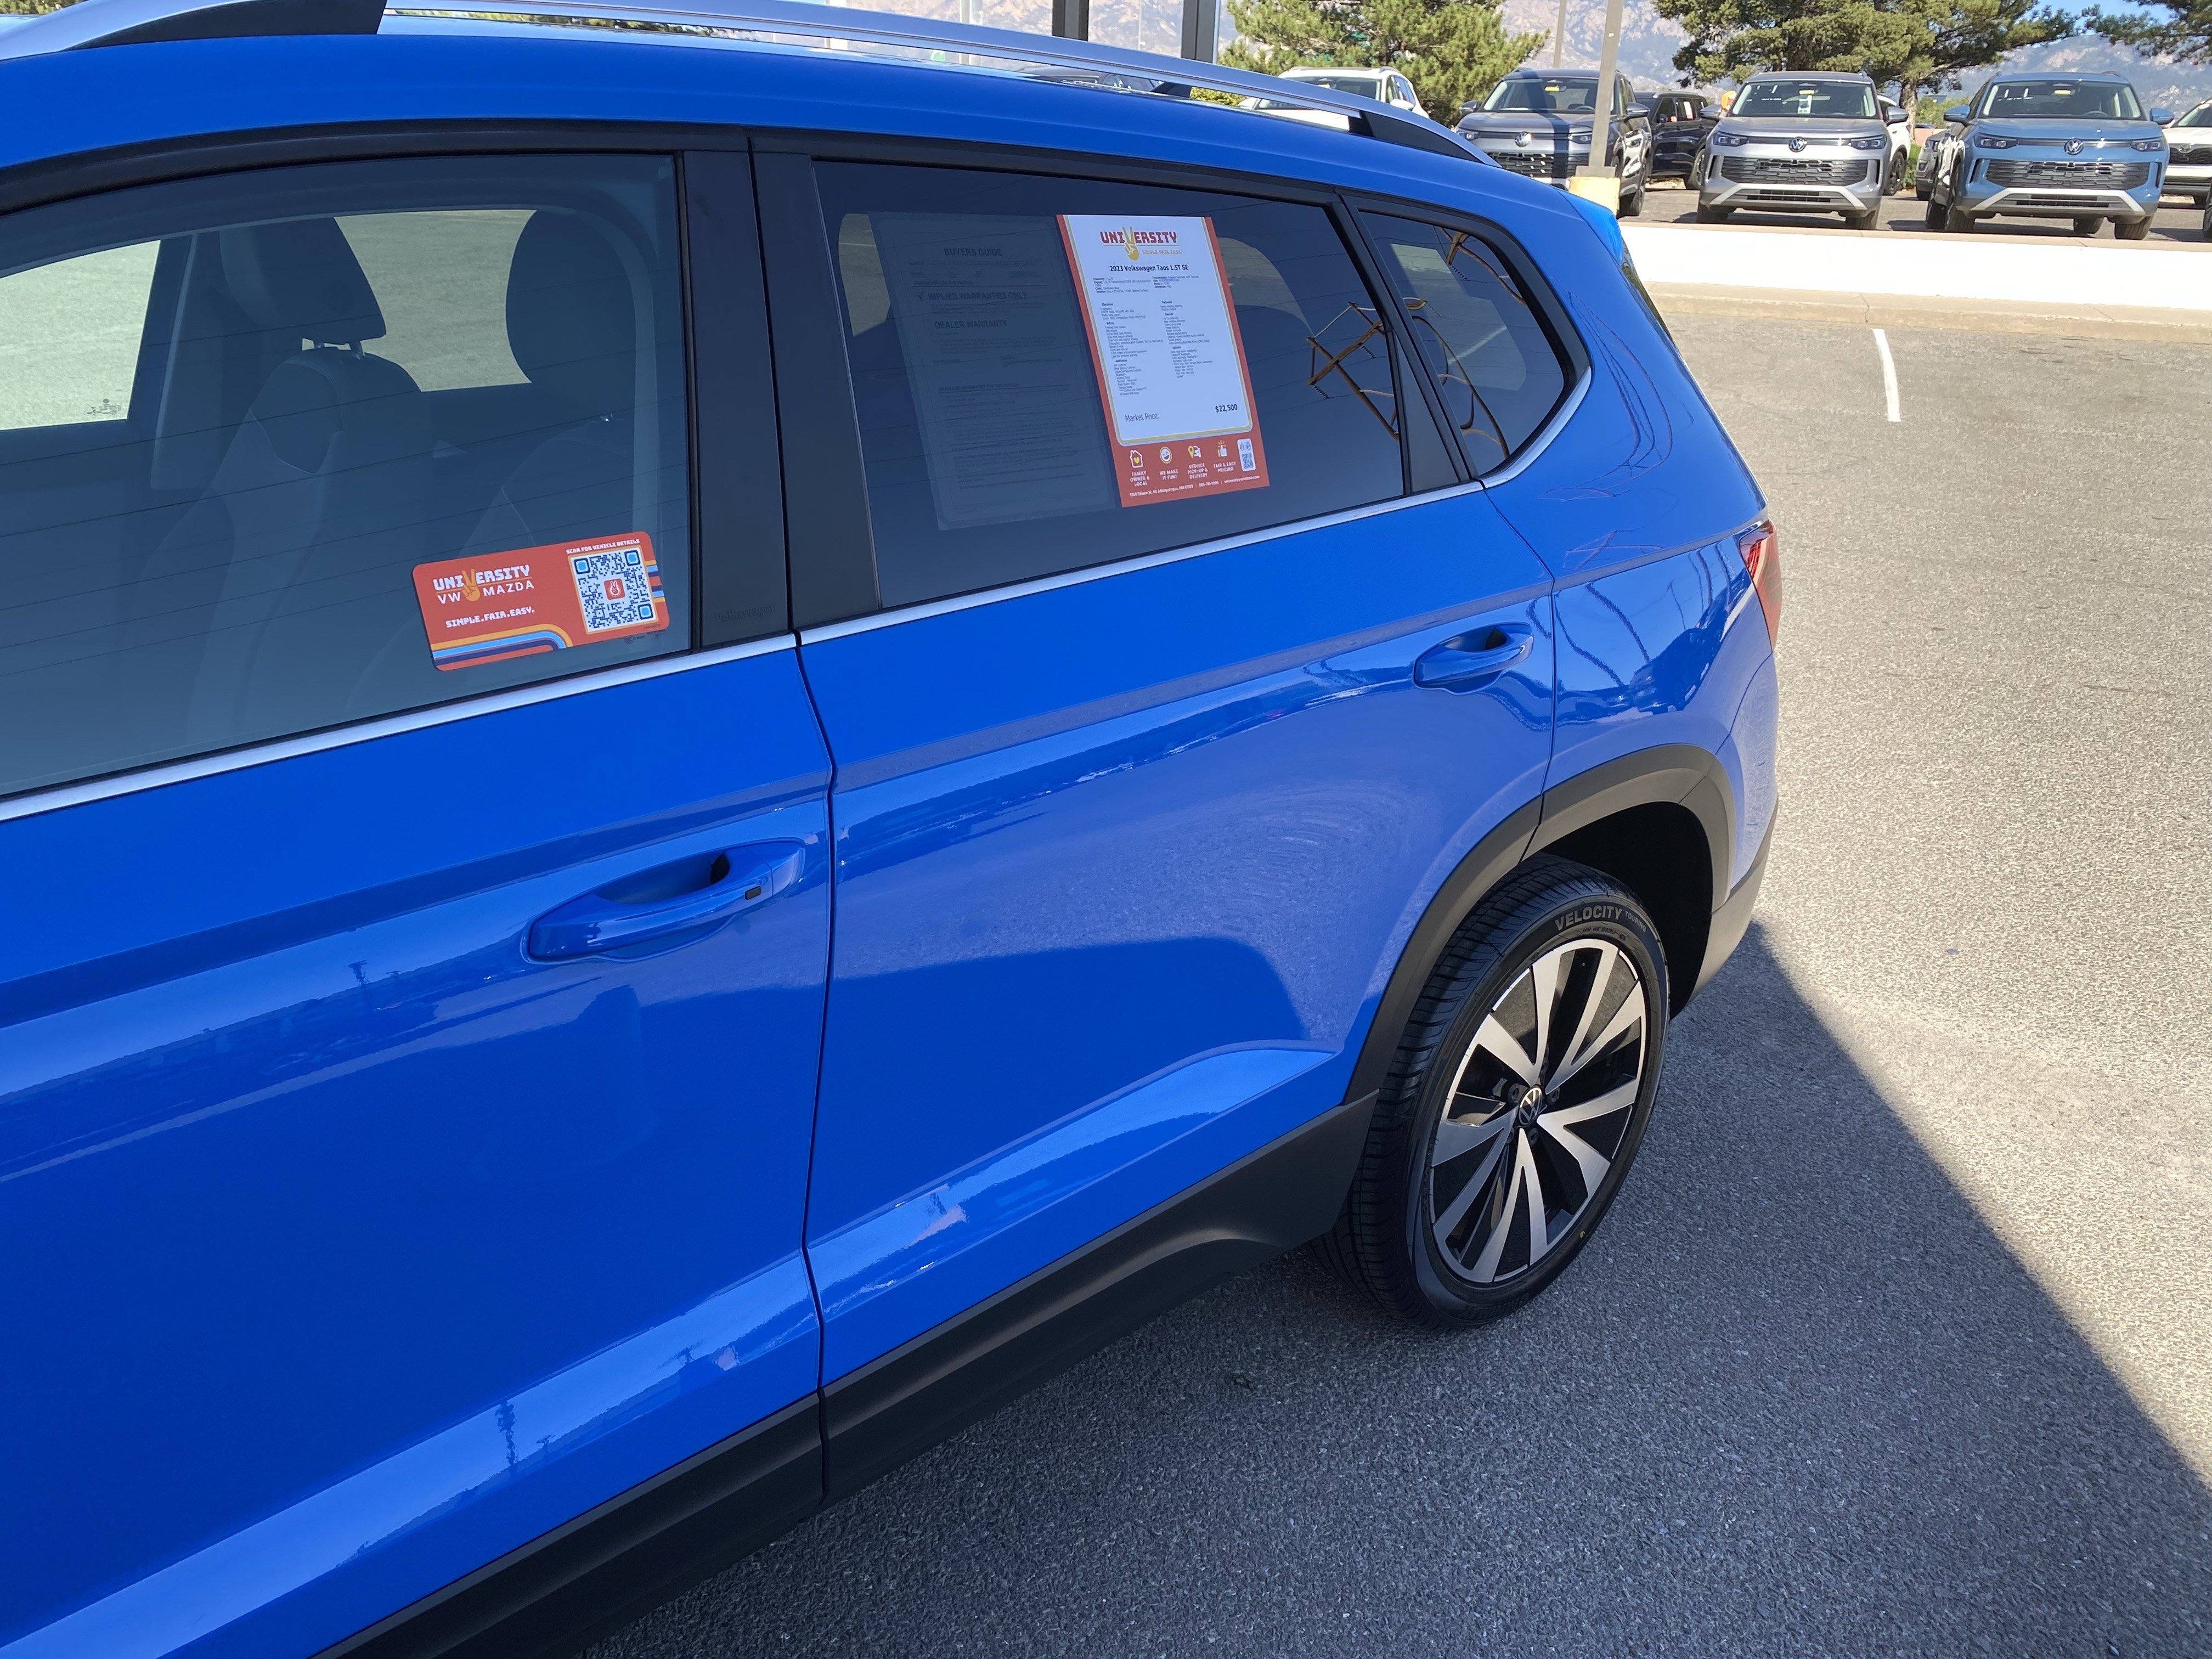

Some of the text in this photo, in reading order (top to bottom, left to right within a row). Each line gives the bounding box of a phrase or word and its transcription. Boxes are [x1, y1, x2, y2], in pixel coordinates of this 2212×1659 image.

[944, 248, 1003, 257] BUYERS GUIDE
[1124, 264, 1156, 273] Volkswagen
[928, 291, 1028, 301] IMPLIED WARRANTIES ONLY
[935, 319, 1007, 329] DEALER WARRANTY
[1215, 403, 1238, 413] $22,500
[1125, 413, 1144, 422] Market
[592, 542, 616, 550] VEHICLE
[433, 564, 530, 591] UNIVERSITY
[437, 580, 535, 604] VW MAZDA
[1554, 905, 1647, 933] VELOCITY TOURING
